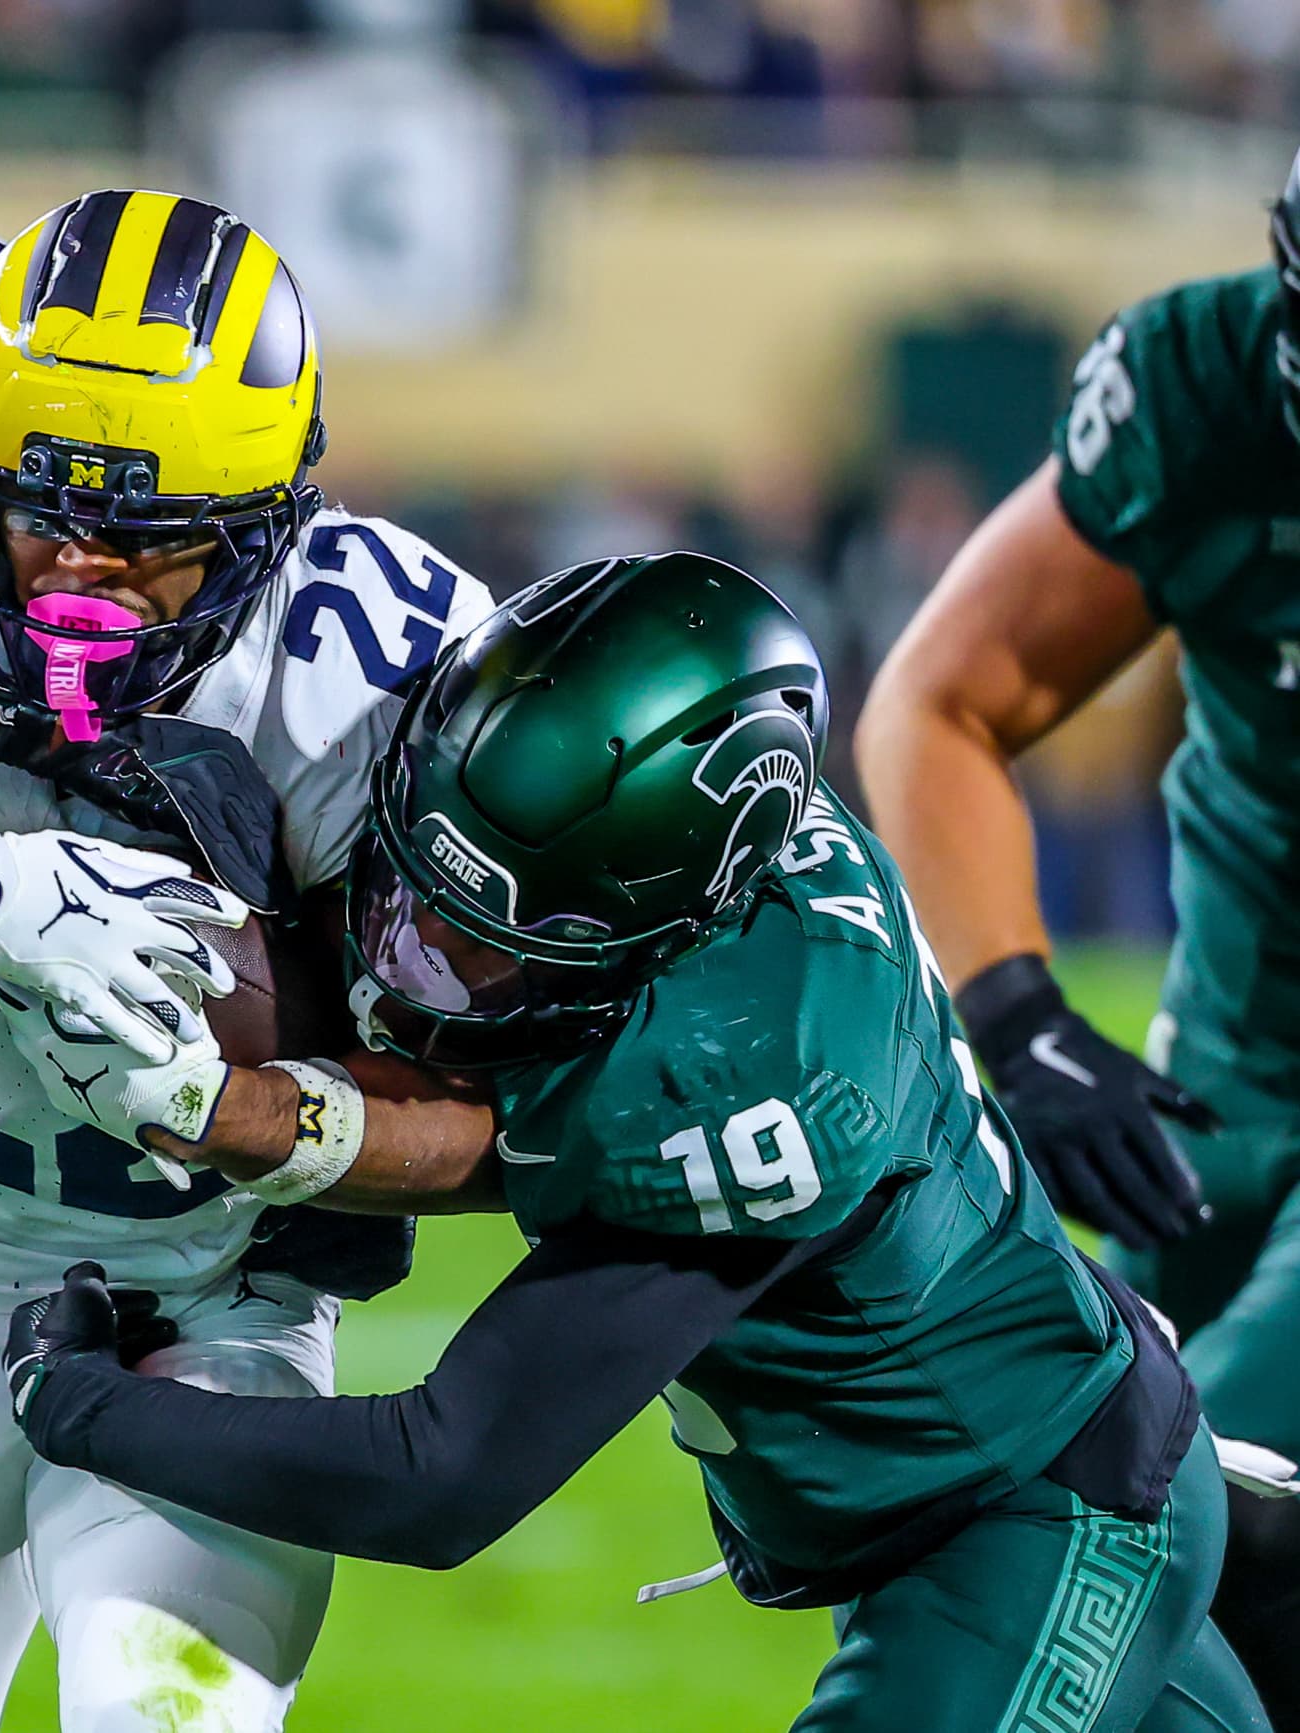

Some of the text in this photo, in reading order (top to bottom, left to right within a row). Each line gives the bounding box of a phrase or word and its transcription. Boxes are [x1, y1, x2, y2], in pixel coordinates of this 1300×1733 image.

[69, 462, 105, 489] M
[282, 524, 457, 700] 22
[431, 833, 491, 893] STATE
[660, 1097, 822, 1233] 19
